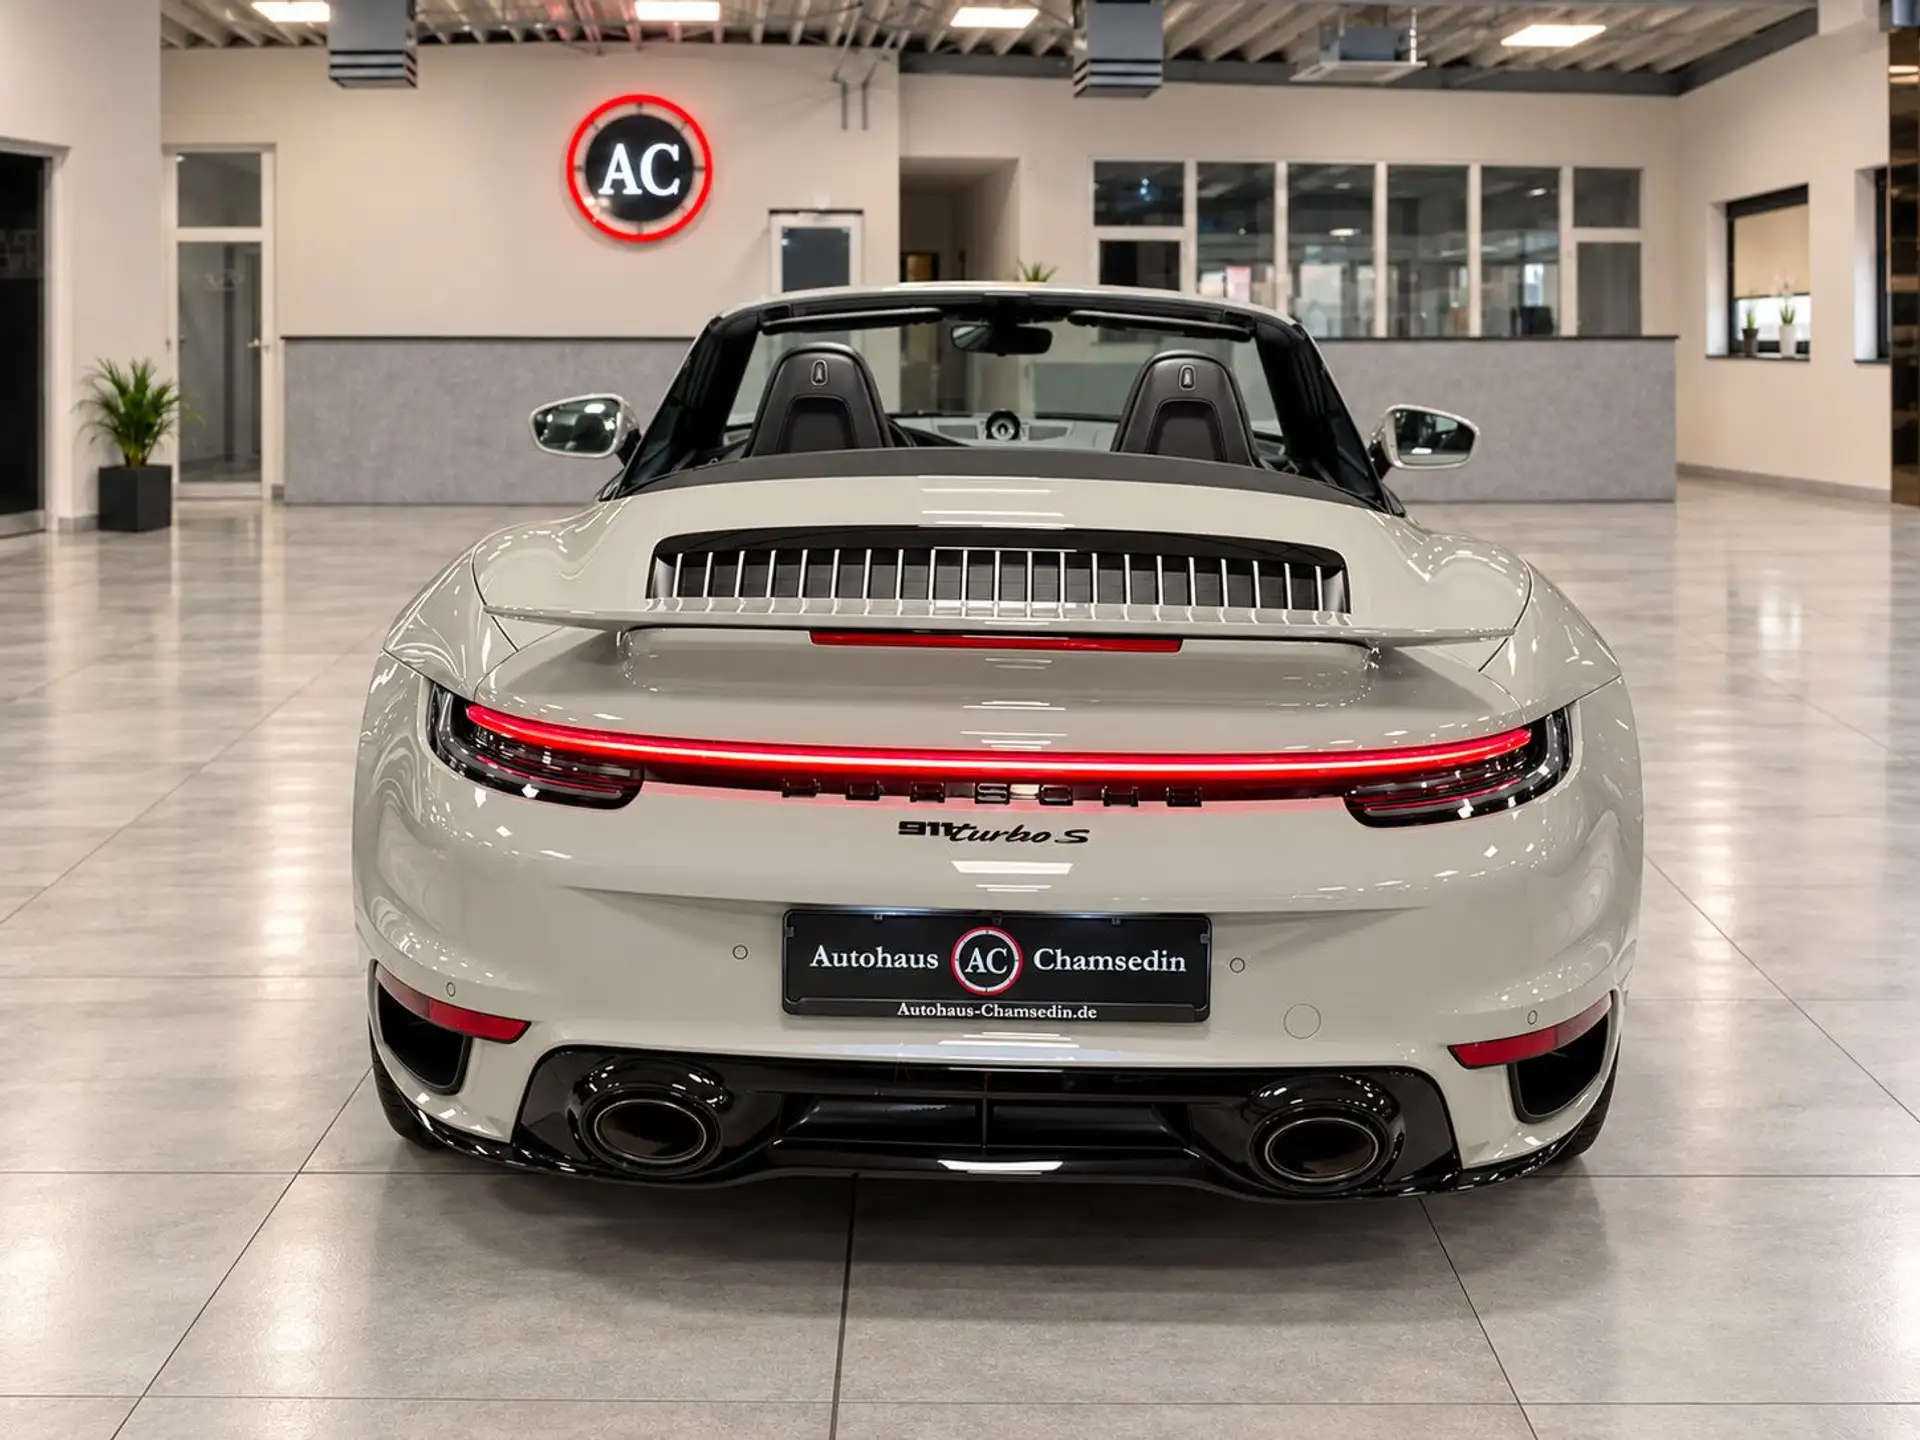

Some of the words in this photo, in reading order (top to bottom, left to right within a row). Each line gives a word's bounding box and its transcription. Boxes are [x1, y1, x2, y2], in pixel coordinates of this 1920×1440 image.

[597, 142, 681, 197] AC
[898, 820, 955, 837] 911
[948, 823, 1053, 843] turbo
[1053, 828, 1090, 845] S
[809, 944, 940, 970] Autohaus
[963, 946, 1009, 975] AC
[1033, 947, 1187, 973] Chamsedin
[897, 1002, 1098, 1020] Autohaus-Chamsedin.de
